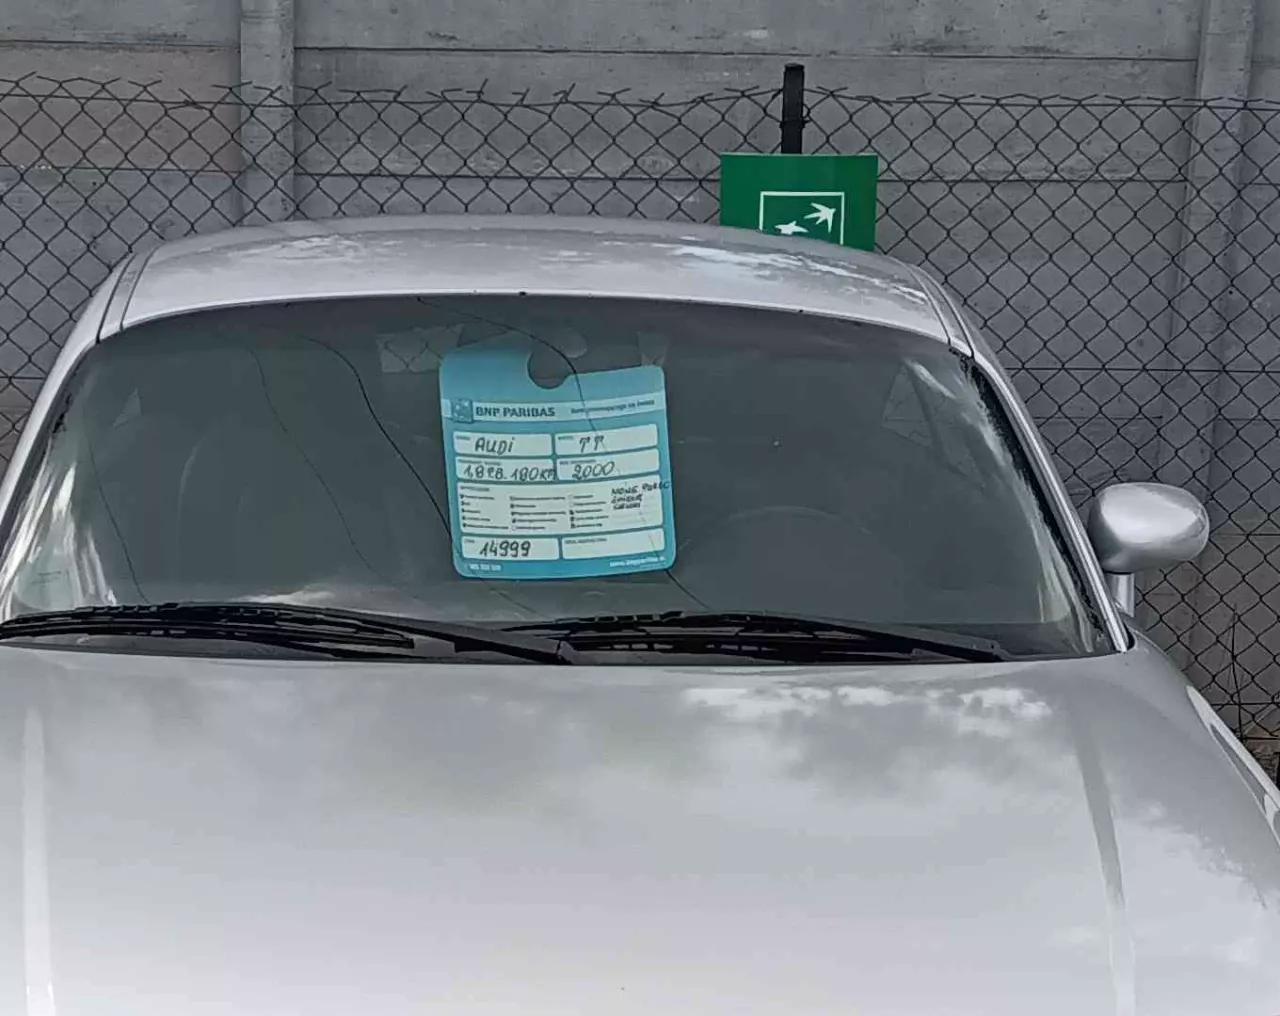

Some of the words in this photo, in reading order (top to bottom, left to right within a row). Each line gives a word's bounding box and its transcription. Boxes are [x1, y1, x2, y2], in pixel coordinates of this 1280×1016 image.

[475, 406, 500, 417] BNP
[502, 406, 556, 418] PARIBAS
[572, 460, 615, 480] 2000
[479, 540, 531, 558] 14999
